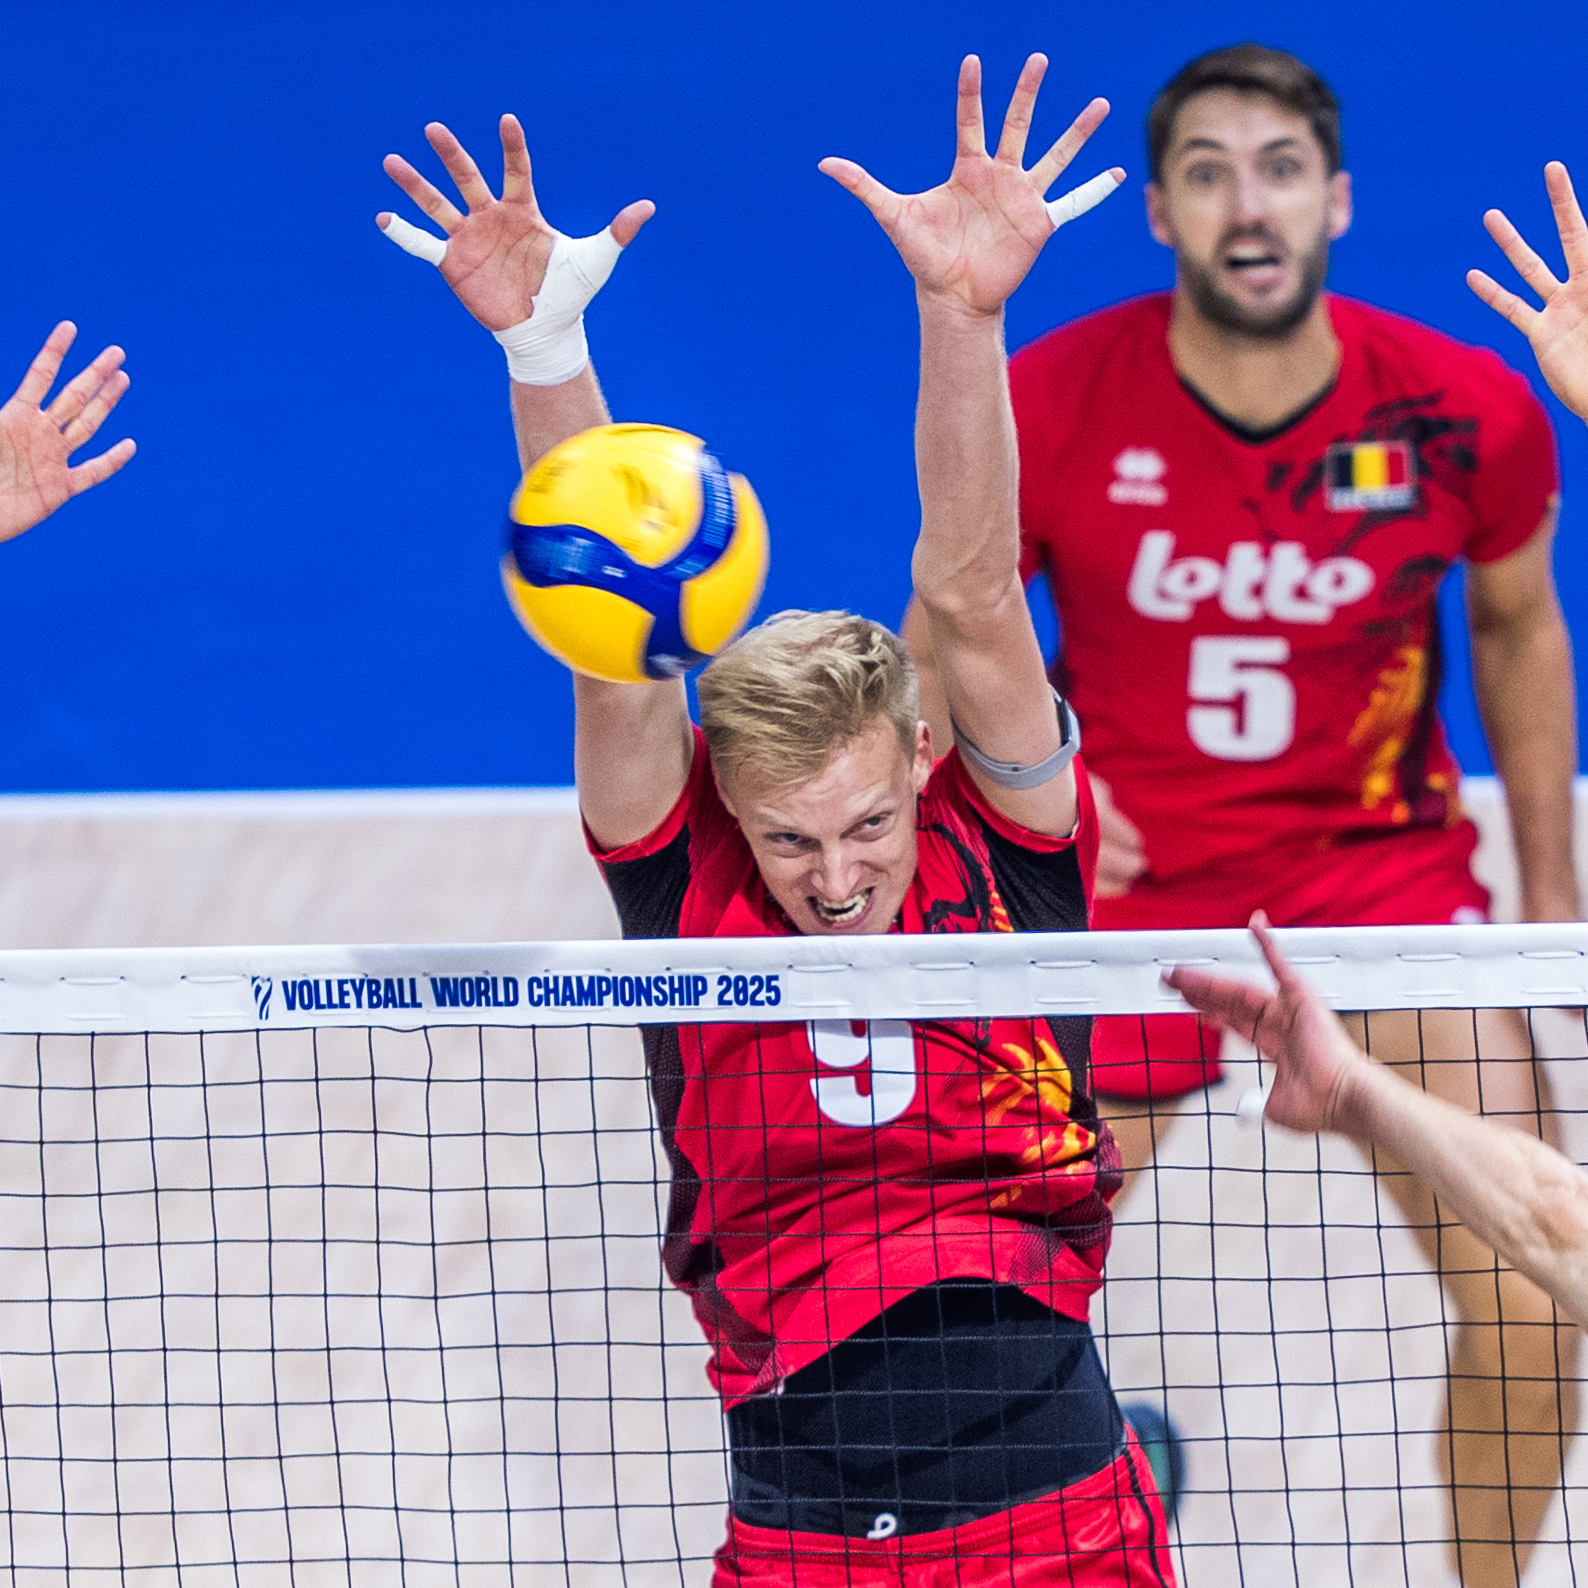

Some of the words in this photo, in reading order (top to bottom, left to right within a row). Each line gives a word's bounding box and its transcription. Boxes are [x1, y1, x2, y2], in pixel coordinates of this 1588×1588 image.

[1127, 529, 1374, 624] Lotto
[1187, 634, 1295, 762] 5
[281, 977, 423, 1011] VOLLEYBALL
[429, 976, 520, 1008] WORLD
[527, 974, 709, 1008] CHAMPIONSHIP
[716, 974, 782, 1007] 2025
[806, 1018, 917, 1128] 9
